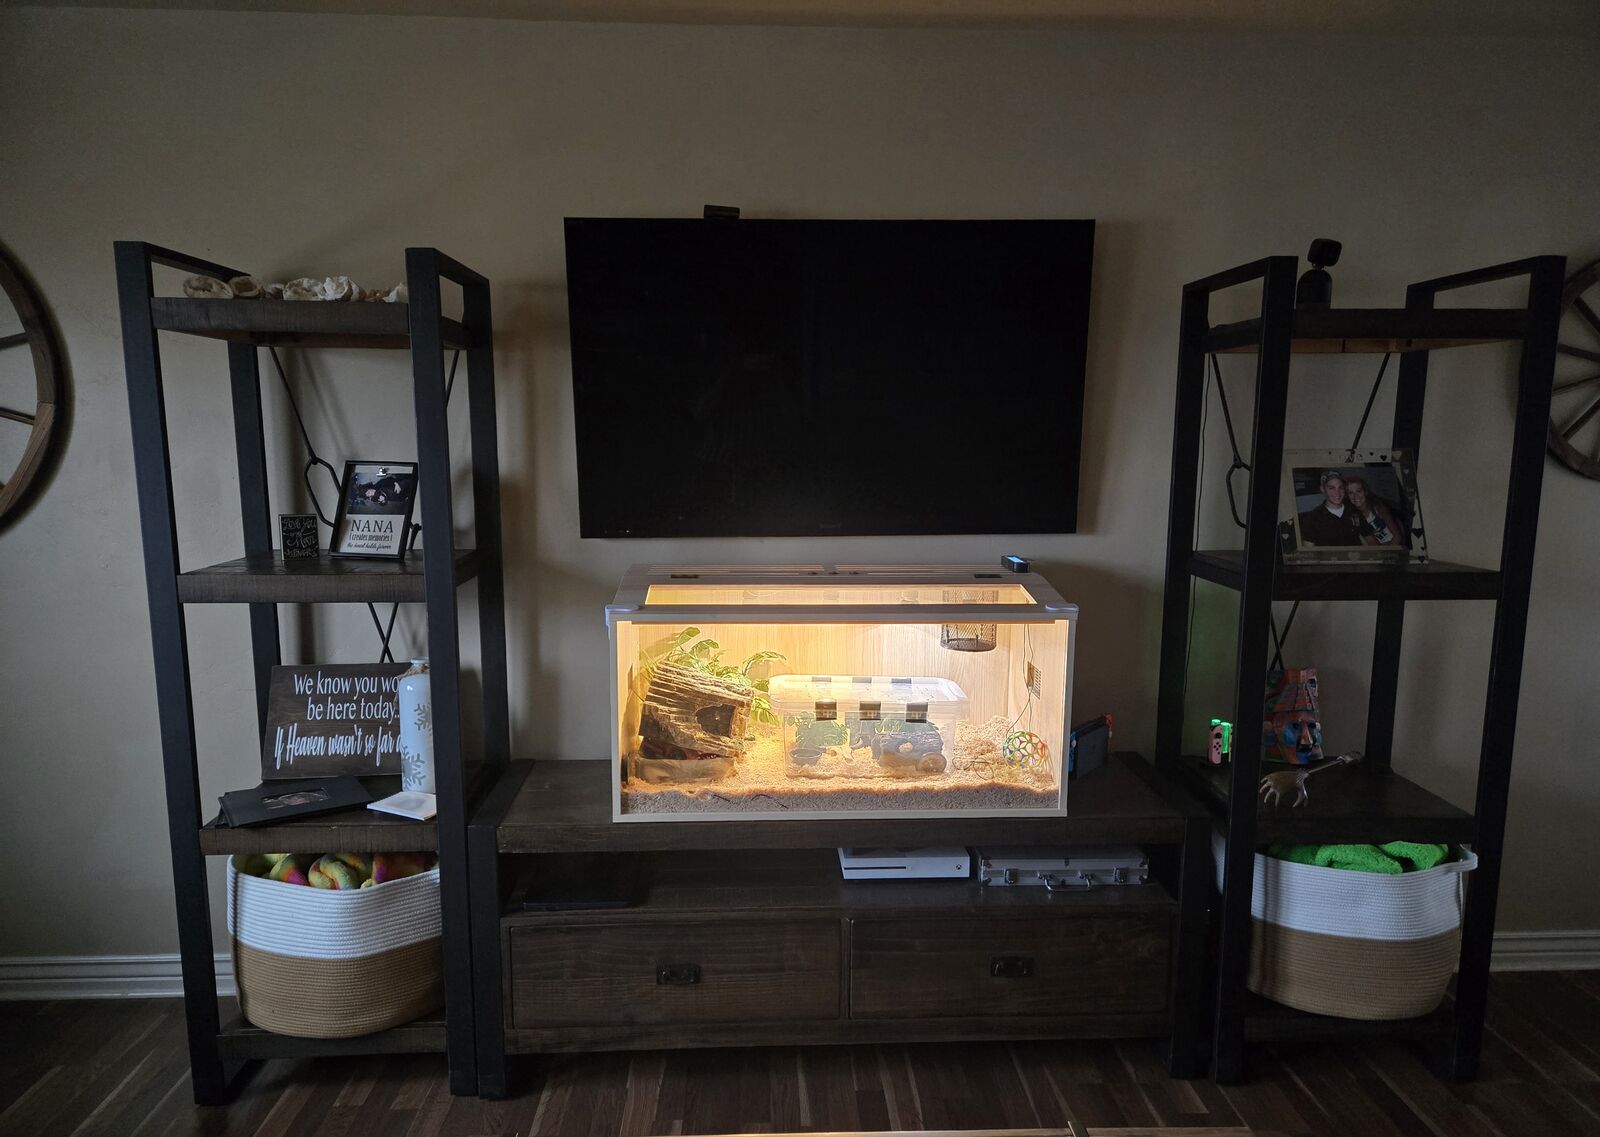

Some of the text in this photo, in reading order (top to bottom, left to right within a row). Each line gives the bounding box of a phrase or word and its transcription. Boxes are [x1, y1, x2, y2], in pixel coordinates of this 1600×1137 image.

[351, 520, 393, 532] NANA
[294, 671, 399, 700] We know you wo
[307, 697, 323, 720] be
[327, 697, 356, 720] here
[275, 726, 284, 770] If
[286, 723, 326, 765] Heaven
[328, 724, 362, 757] wasn't
[364, 734, 374, 756] so
[376, 726, 393, 767] far
